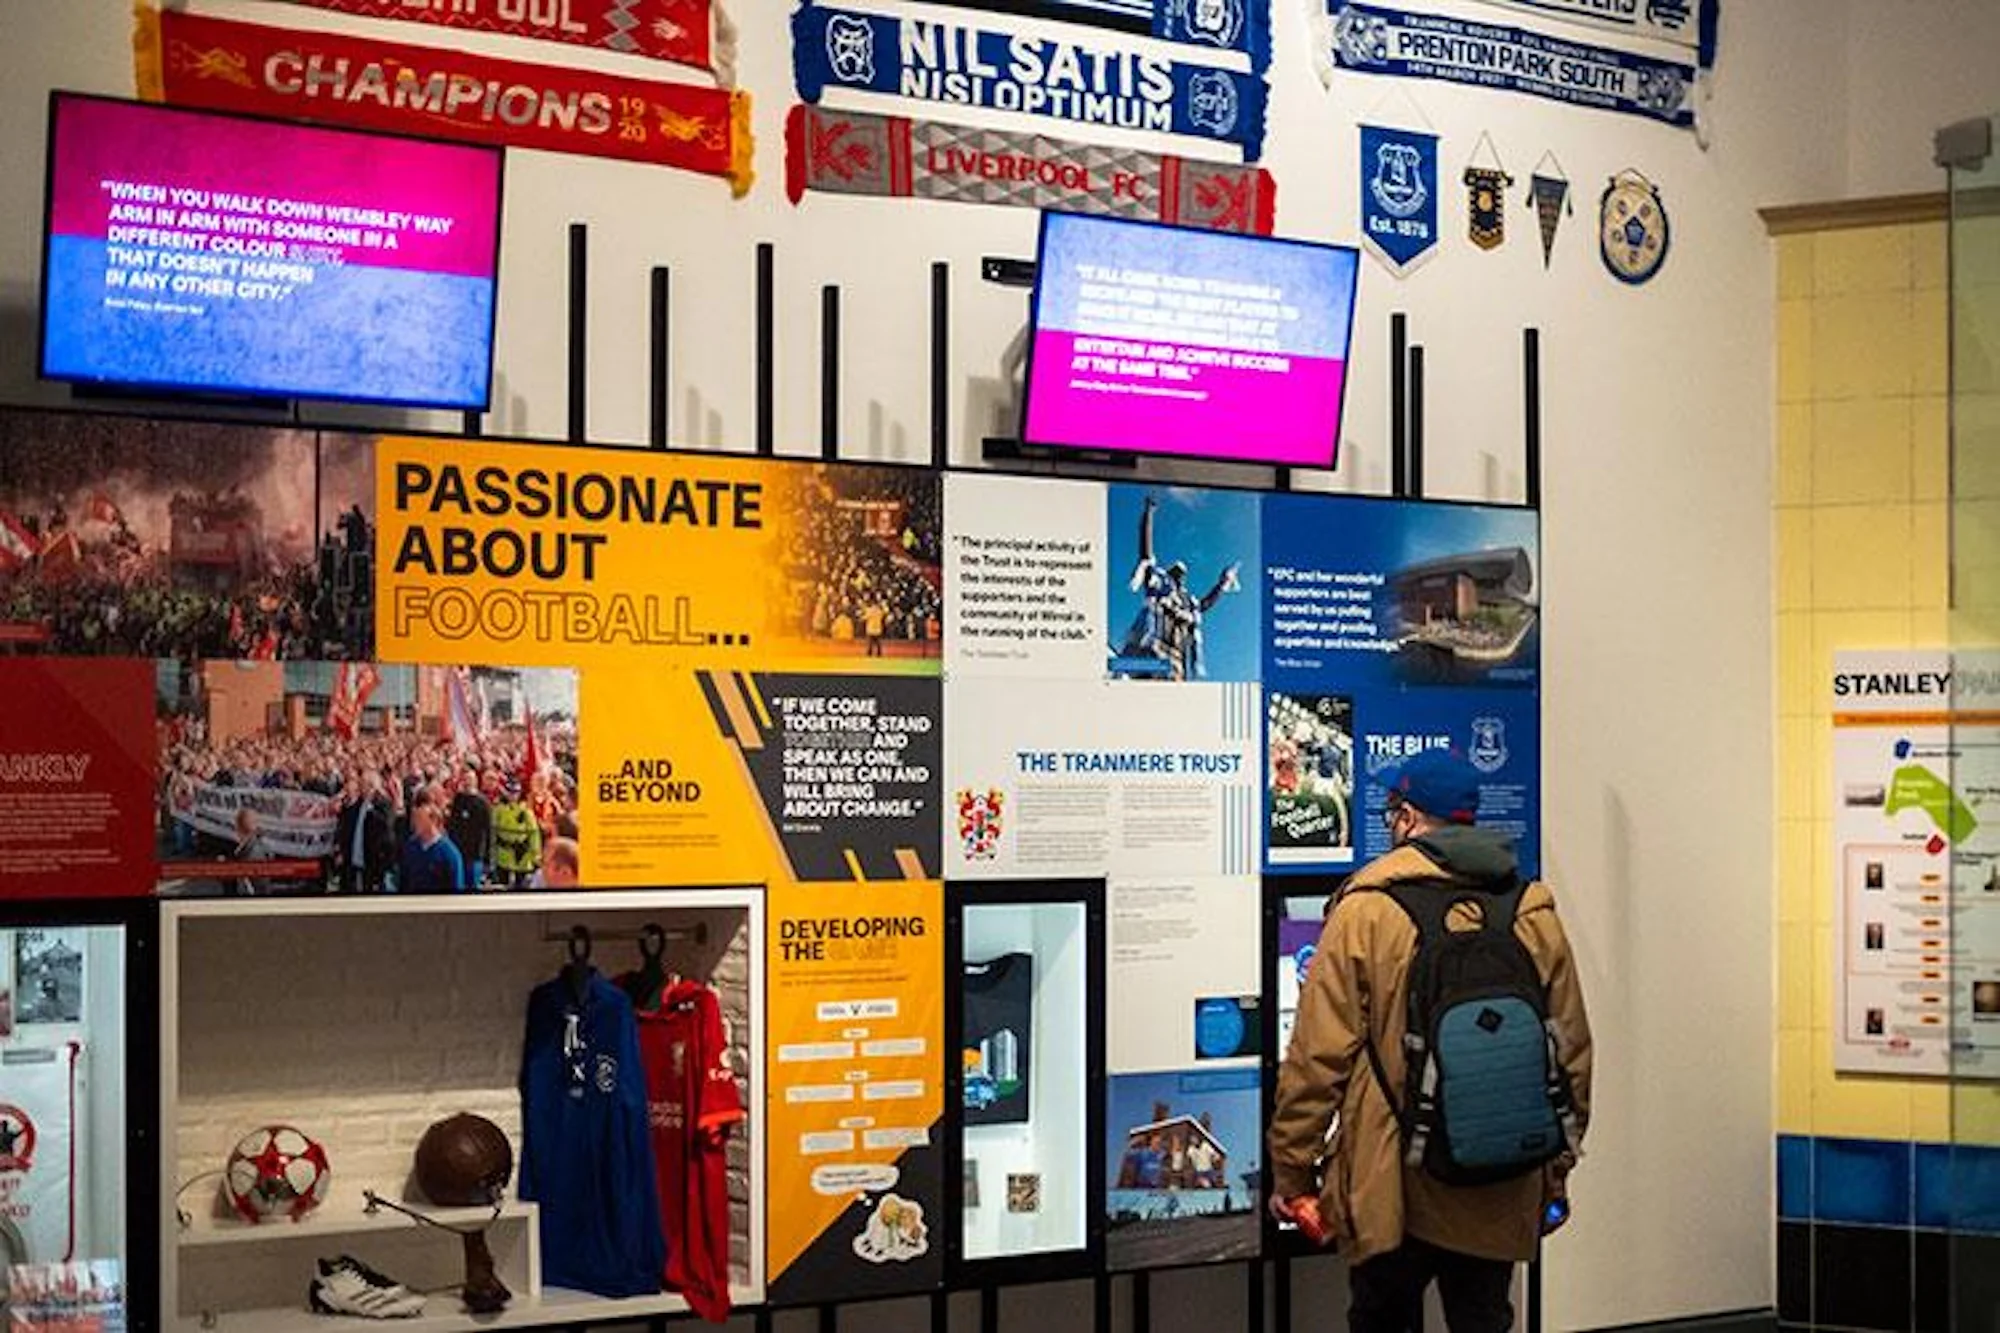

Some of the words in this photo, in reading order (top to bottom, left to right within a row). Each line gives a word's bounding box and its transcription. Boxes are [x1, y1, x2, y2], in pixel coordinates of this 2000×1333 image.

[899, 20, 998, 79] NIL
[1009, 30, 1174, 104] SATIS
[1399, 32, 1497, 68] PRENTON
[1500, 47, 1554, 81] PARK
[1559, 60, 1625, 94] SOUTH
[264, 50, 612, 135] CHAMPIONS
[901, 68, 985, 106] NISI
[994, 78, 1173, 133] OPTIMUM
[619, 97, 644, 117] 19
[619, 122, 647, 142] 20
[927, 146, 1094, 193] LIVERPOOL
[1112, 170, 1146, 200] FC
[171, 188, 209, 208] YOU
[213, 192, 263, 214] WALK
[267, 199, 325, 221] DOWN
[325, 206, 411, 229] WEMBLEY
[414, 216, 454, 234] WAY
[109, 204, 152, 224] ARM
[156, 209, 174, 226] IN
[178, 211, 219, 231] ARM
[222, 215, 269, 235] WITH
[270, 220, 359, 246] SOMEONE
[362, 230, 382, 248] IN
[383, 232, 398, 249] A
[1369, 214, 1394, 233] Est.
[108, 226, 207, 249] DIFFERENT
[210, 235, 286, 258] COLOUR
[108, 247, 157, 265] THAT
[160, 253, 239, 276] DOESN'T
[242, 260, 314, 282] HAPPEN
[106, 268, 125, 286] IN
[128, 271, 169, 290] ANY
[173, 276, 234, 297] OTHER
[394, 462, 763, 530] PASSIONATE
[393, 525, 607, 581] ABOUT
[984, 537, 1032, 553] principal
[1036, 539, 1076, 555] activity
[1079, 541, 1091, 552] of
[961, 554, 980, 567] the
[983, 555, 1011, 568] Trust
[1014, 557, 1022, 568] is
[1025, 558, 1036, 569] to
[1038, 560, 1092, 572] represent
[961, 572, 980, 584] the
[983, 574, 1032, 587] interests
[1034, 576, 1046, 587] of
[1047, 576, 1066, 587] the
[1296, 571, 1315, 583] and
[1334, 572, 1385, 585] wonderful
[961, 590, 1022, 604] supporters
[1026, 591, 1045, 604] and
[1047, 592, 1066, 604] the
[393, 586, 751, 647] FOOTBALL...
[961, 608, 1025, 622] community
[1028, 610, 1039, 621] of
[961, 625, 980, 637] the
[982, 627, 1025, 641] running
[1027, 628, 1039, 639] of
[1040, 628, 1057, 639] the
[1834, 672, 1951, 696] STANLEY
[800, 697, 826, 715] WE
[827, 698, 877, 716] COME
[783, 716, 876, 733] TOGETHER,
[877, 716, 931, 732] STAND
[873, 733, 908, 749] AND
[1365, 735, 1401, 755] THE
[783, 750, 838, 767] SPEAK
[840, 750, 862, 767] AS
[1017, 752, 1056, 773] THE
[1063, 752, 1174, 774] TRANMERE
[1179, 754, 1243, 774] TRUST
[783, 767, 828, 783] THEN
[829, 767, 856, 783] WE
[856, 767, 892, 783] CAN
[893, 767, 928, 783] AND
[598, 781, 701, 802] BEYOND
[783, 783, 822, 800] WILL
[823, 783, 874, 800] BRING
[783, 800, 841, 818] ABOUT
[780, 917, 926, 939] DEVELOPING
[780, 940, 825, 961] THE
